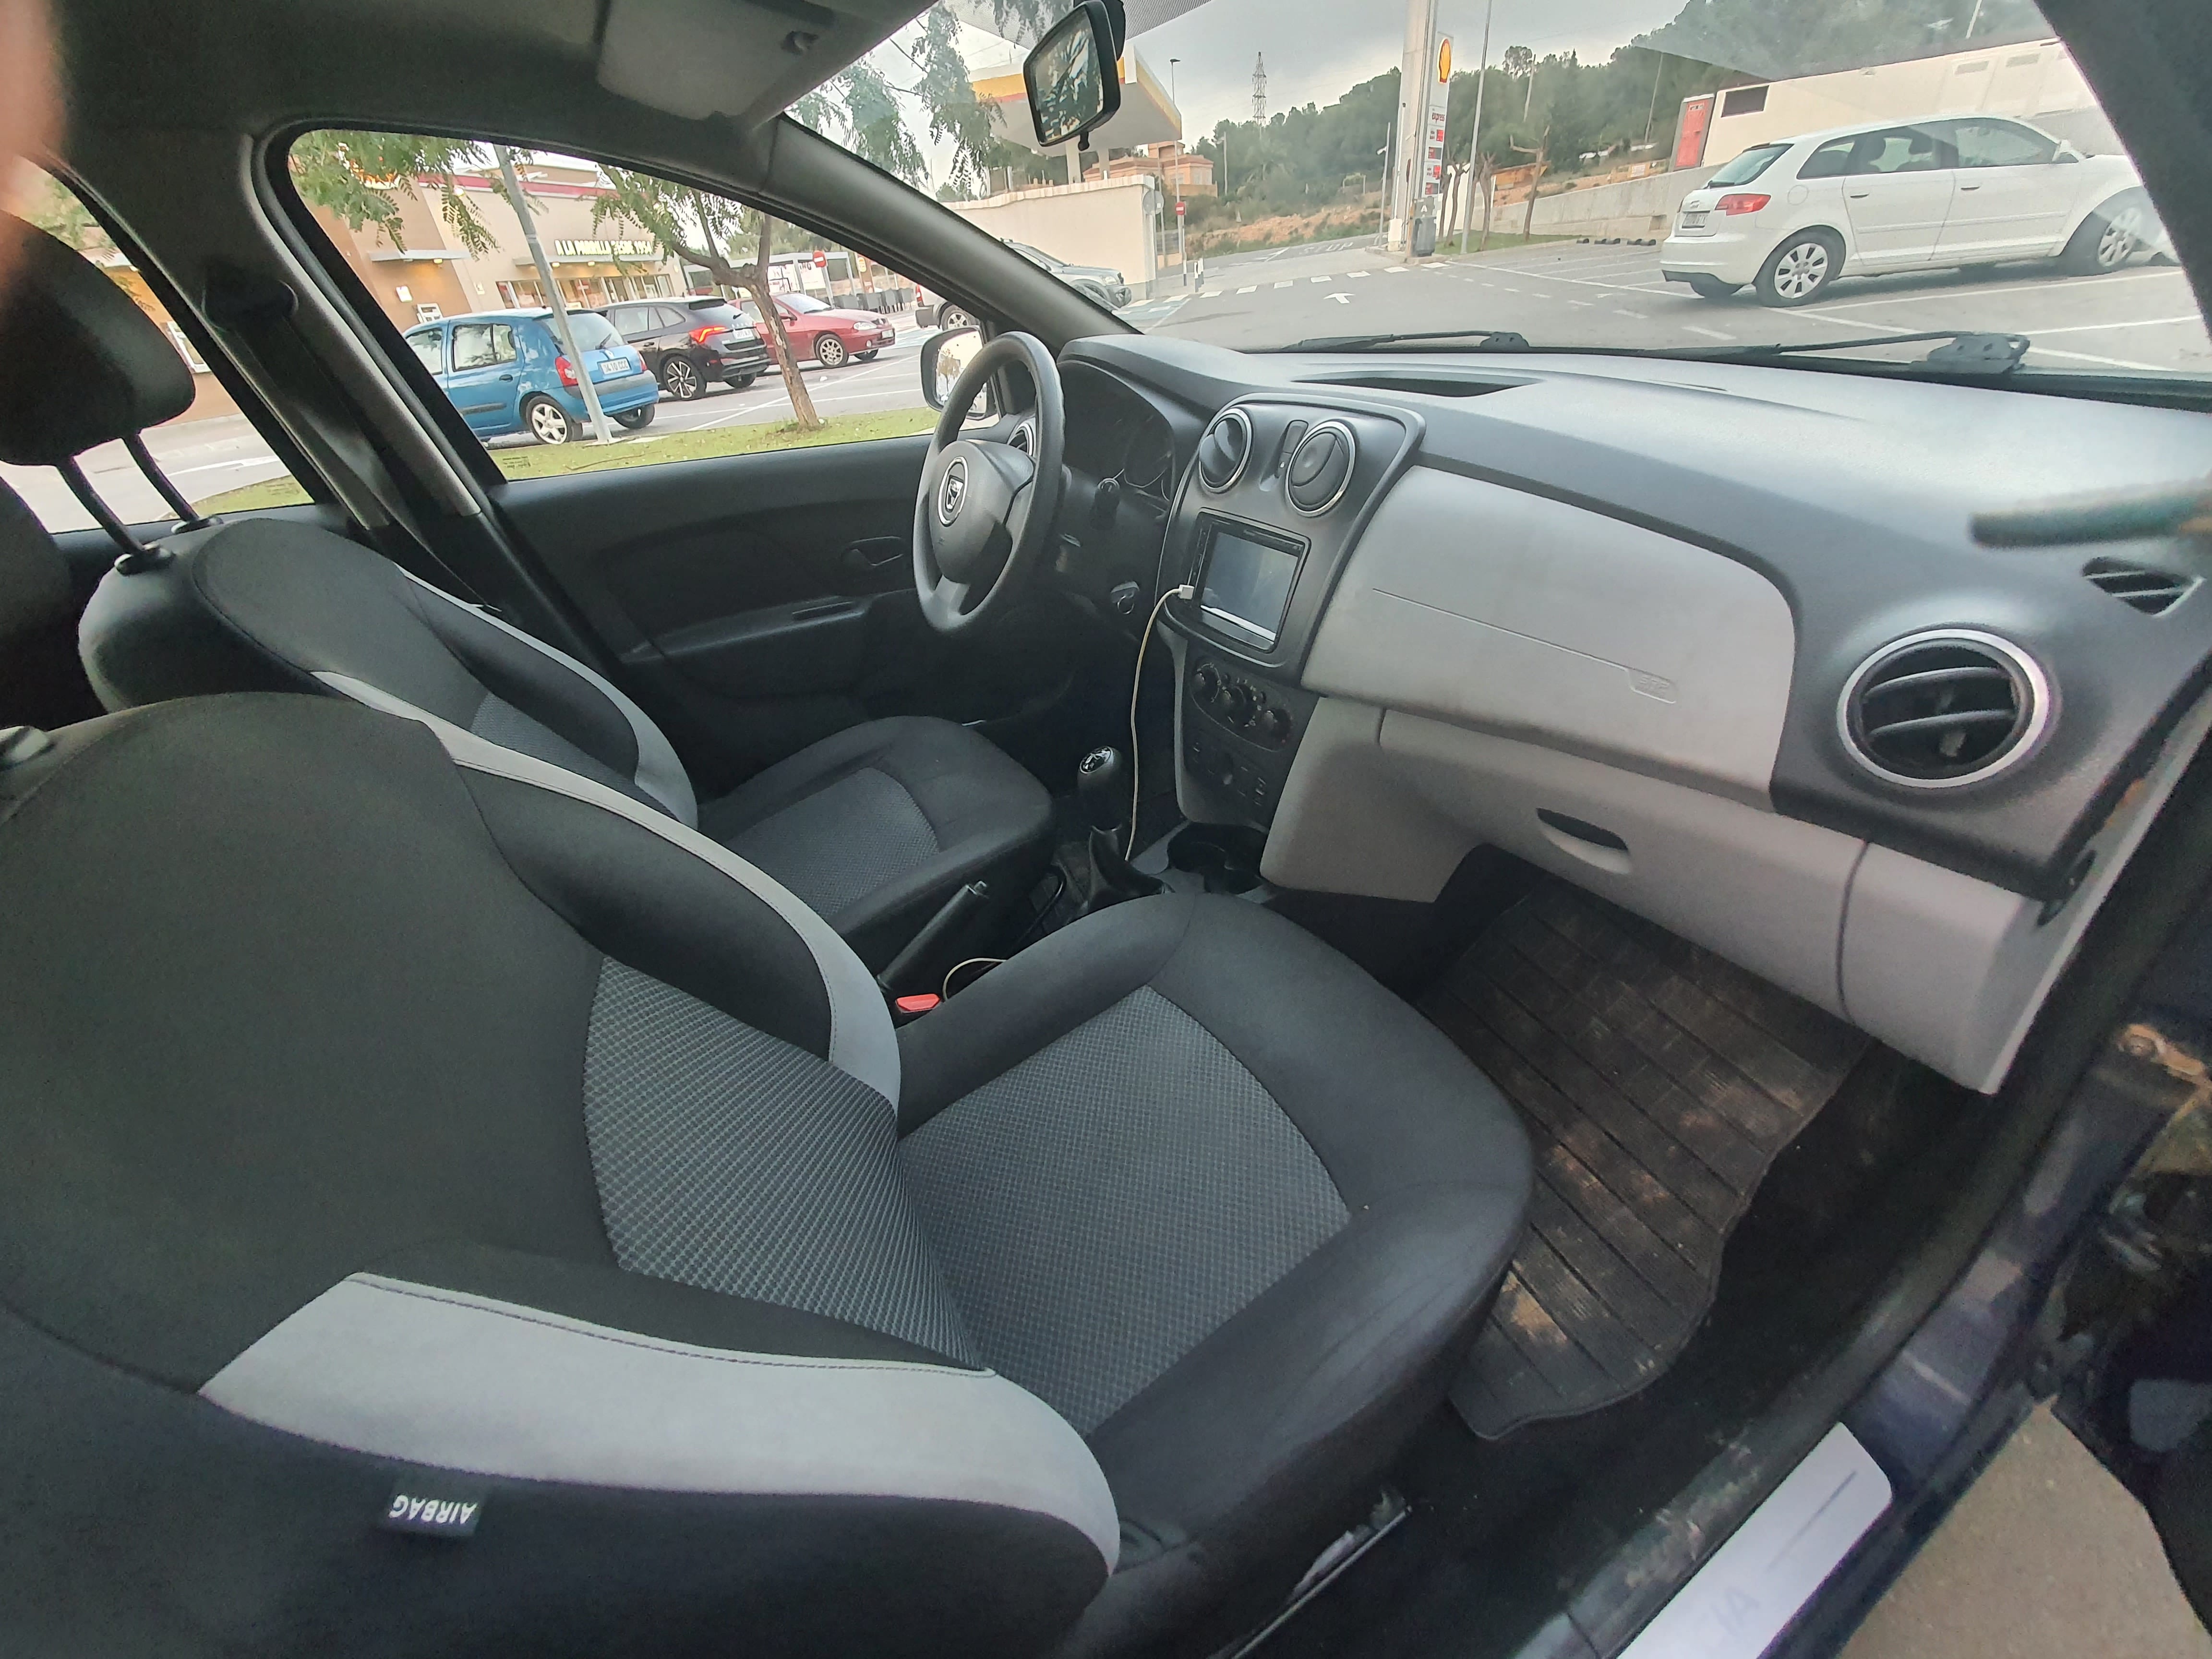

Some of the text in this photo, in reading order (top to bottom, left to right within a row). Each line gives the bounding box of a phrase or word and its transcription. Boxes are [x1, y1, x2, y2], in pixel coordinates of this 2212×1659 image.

[1431, 114, 1445, 124] express
[555, 240, 565, 255] A
[562, 240, 576, 255] LA
[388, 1494, 478, 1525] AIRBAG
